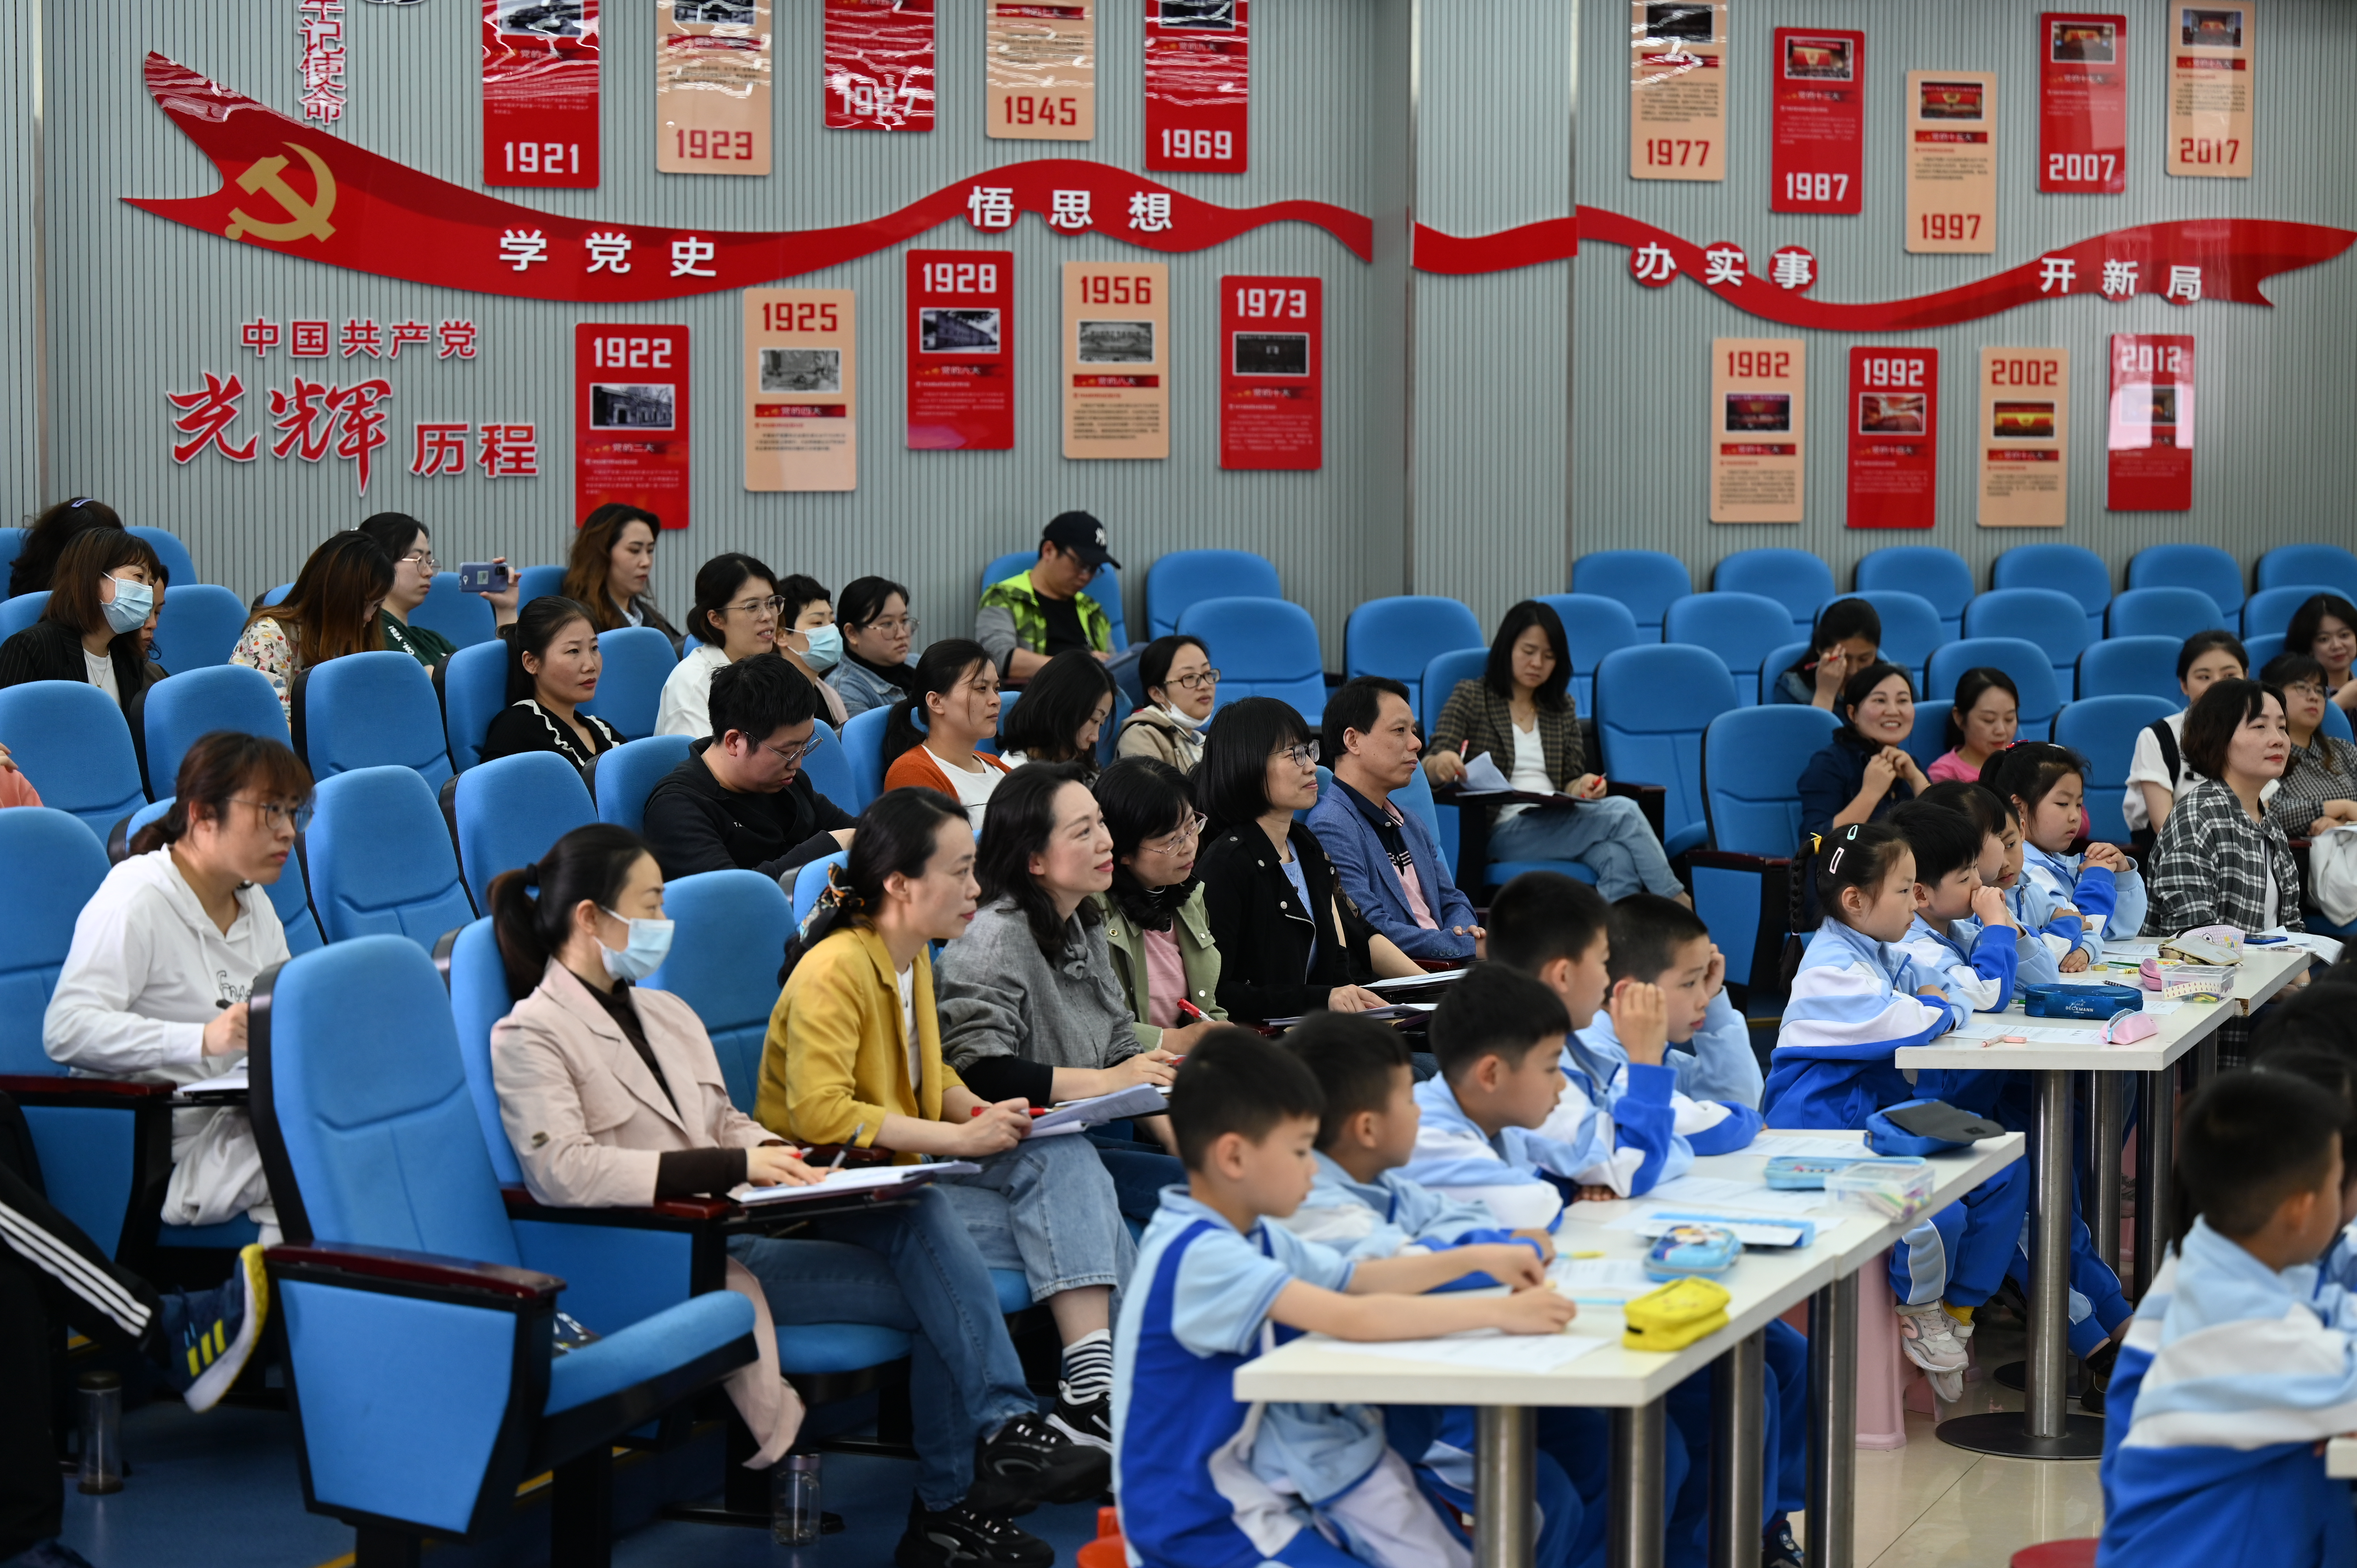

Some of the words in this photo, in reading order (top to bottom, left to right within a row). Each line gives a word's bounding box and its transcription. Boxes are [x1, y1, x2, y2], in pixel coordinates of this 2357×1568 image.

[1005, 95, 1076, 126] 1945
[504, 141, 579, 174] 1921
[677, 129, 753, 161] 1923
[1161, 129, 1232, 159] 1969
[1647, 138, 1710, 167] 1977
[2180, 138, 2240, 164] 2017
[2049, 153, 2116, 181] 2007
[1785, 172, 1849, 201] 1987
[967, 185, 1173, 231] 悟思想
[1921, 213, 1982, 240] 1997
[499, 229, 716, 277] 学党史
[1635, 241, 1813, 289] 办实事
[922, 263, 997, 293] 1928
[1080, 275, 1152, 304] 1956
[2040, 258, 2202, 301] 开新局
[762, 302, 837, 332] 1925
[1236, 288, 1307, 318] 1973
[241, 317, 477, 359] 中国共产党
[594, 337, 672, 368] 1922
[1728, 351, 1790, 378] 1982
[1862, 358, 1924, 387] 1992
[1991, 359, 2058, 386] 2002
[2121, 344, 2182, 373] 2012
[388, 625, 403, 642] YES!
